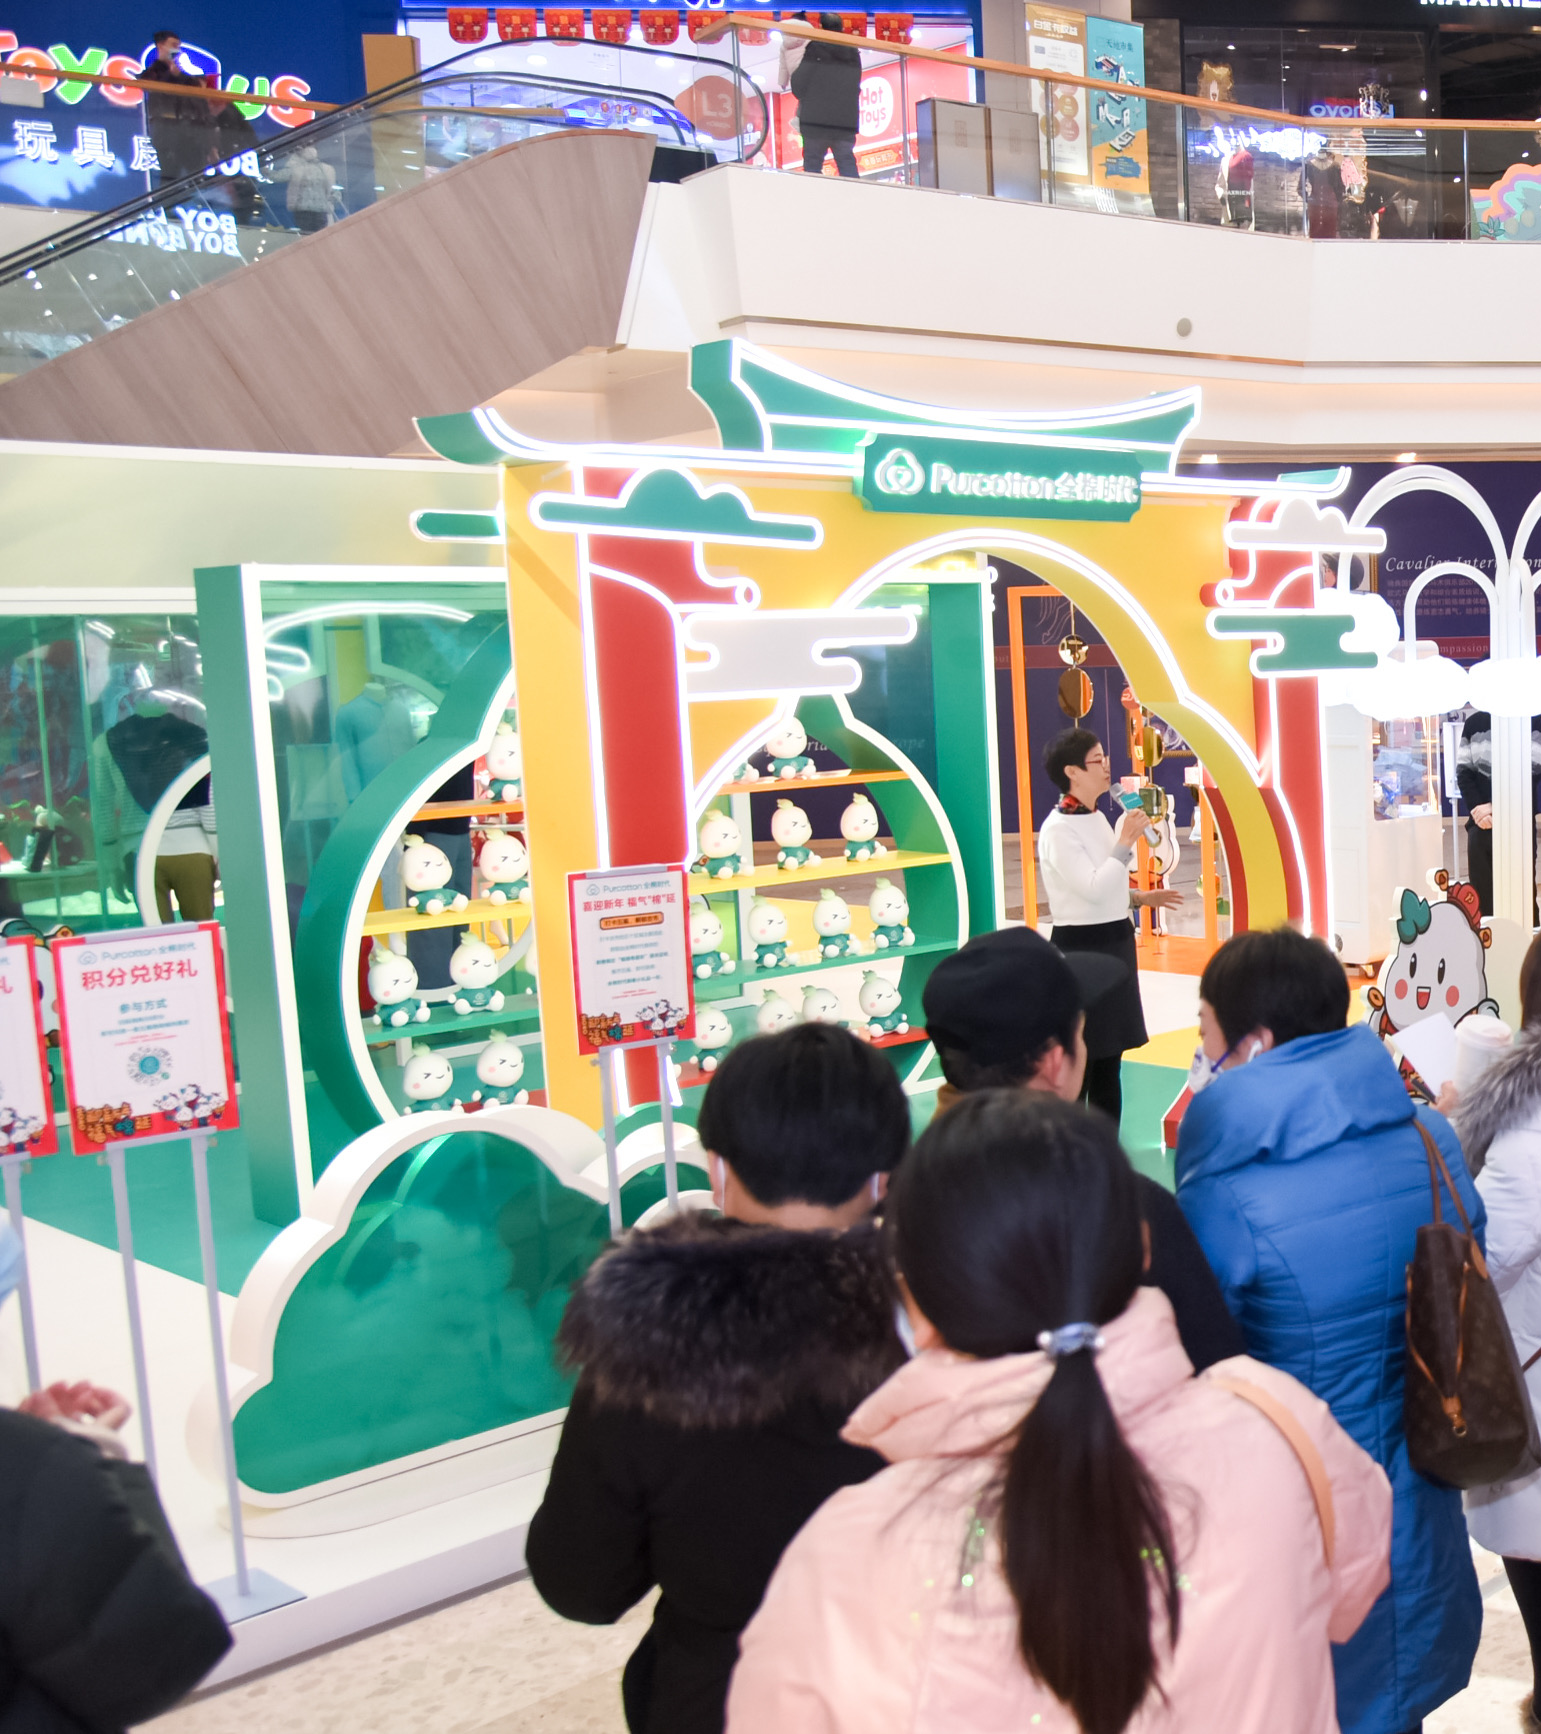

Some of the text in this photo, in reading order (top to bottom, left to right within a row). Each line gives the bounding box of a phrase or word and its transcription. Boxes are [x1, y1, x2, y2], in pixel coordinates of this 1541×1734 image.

[0, 29, 146, 107] oys
[702, 91, 733, 118] L3
[861, 86, 884, 105] Hot
[861, 108, 887, 128] Toys
[930, 461, 1139, 504] Purcotton 全棉时代
[82, 958, 198, 991] 积分兑好礼
[119, 998, 168, 1015] 参与方式
